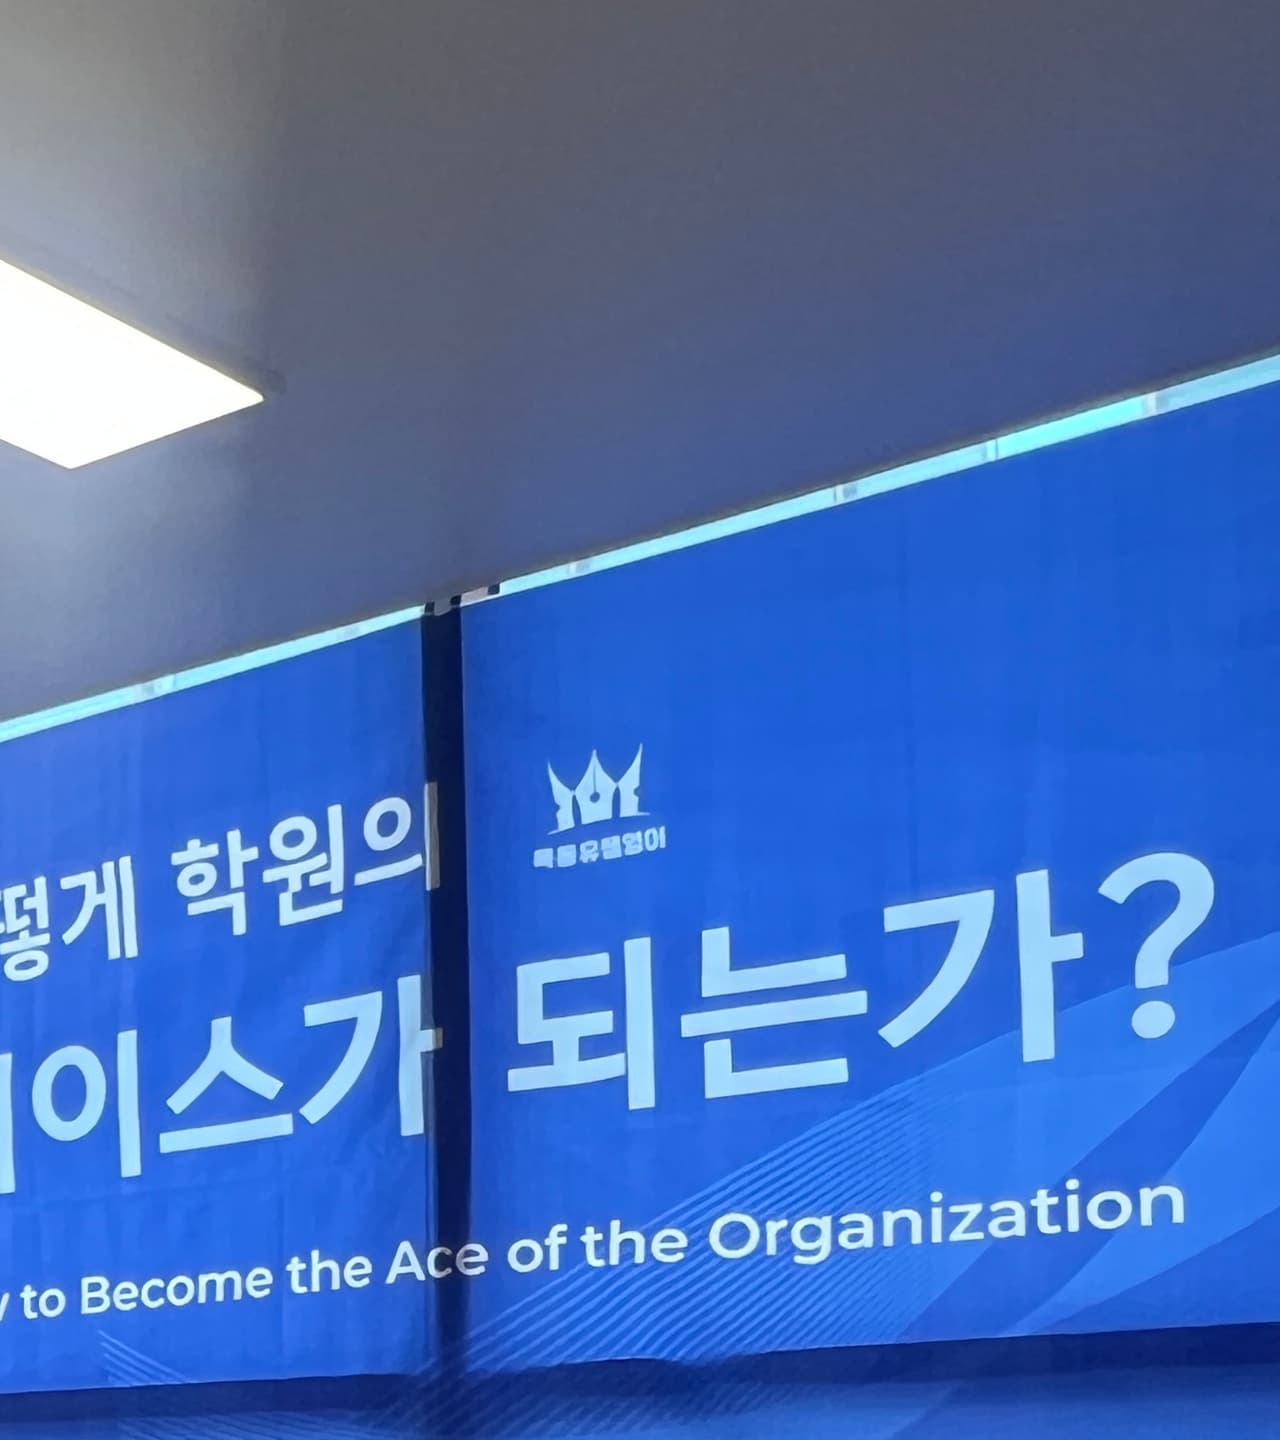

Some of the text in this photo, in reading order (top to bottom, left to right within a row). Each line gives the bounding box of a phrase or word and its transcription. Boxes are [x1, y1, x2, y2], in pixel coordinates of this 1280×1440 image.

[170, 781, 440, 939] 학원의
[506, 850, 1216, 1111] 되는가?
[21, 1284, 65, 1319] to
[81, 1266, 273, 1314] Become
[287, 1250, 372, 1295] the
[385, 1240, 489, 1284] Ace
[507, 1223, 567, 1273] of
[582, 1219, 687, 1268] the
[709, 1179, 1184, 1266] Organization
